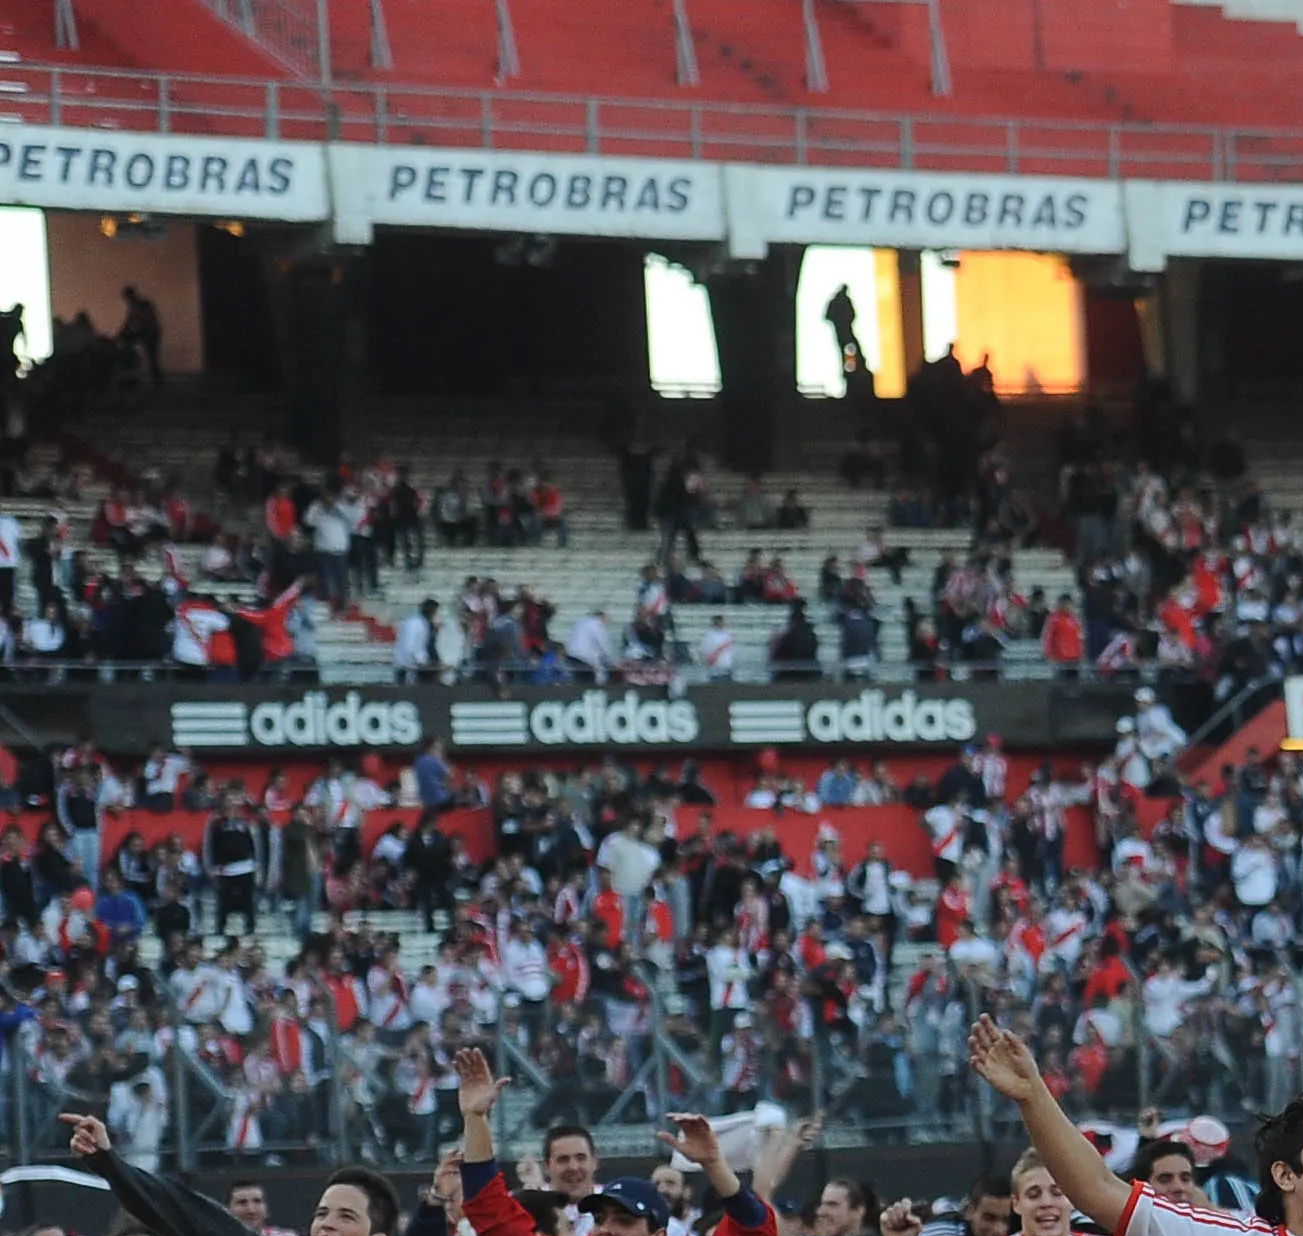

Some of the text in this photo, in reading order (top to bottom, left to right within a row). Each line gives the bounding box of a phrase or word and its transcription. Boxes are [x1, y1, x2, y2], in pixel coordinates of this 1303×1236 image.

[388, 164, 692, 213] PETROBRAS
[786, 185, 1088, 229] PETROBRAS
[250, 691, 422, 746] adidas
[530, 690, 699, 744] adidas
[807, 689, 976, 742] adidas
